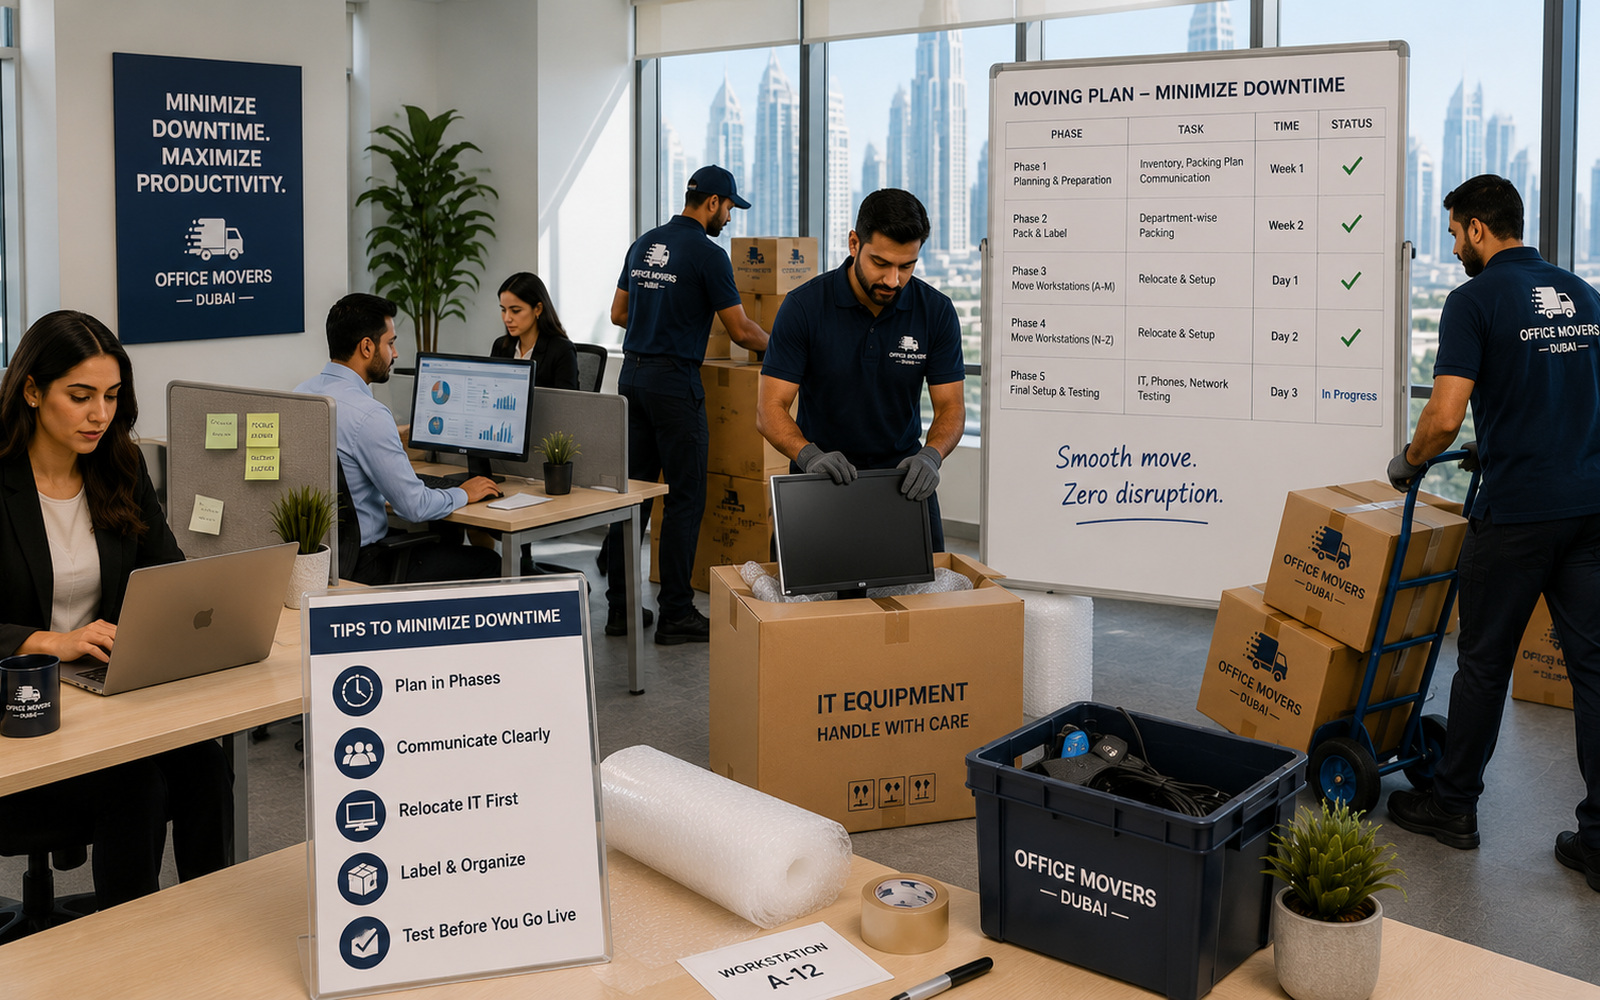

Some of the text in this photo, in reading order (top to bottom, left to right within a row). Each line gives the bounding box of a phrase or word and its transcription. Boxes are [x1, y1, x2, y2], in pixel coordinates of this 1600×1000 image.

[1014, 89, 1082, 107] MOVING
[1088, 87, 1134, 103] PLAN
[1156, 82, 1238, 100] MINIMIZE
[1244, 77, 1345, 96] DOWNTIME
[166, 92, 256, 115] MINIMIZE
[152, 119, 270, 141] DOWNTIME.
[1178, 124, 1204, 134] TASK
[1274, 121, 1299, 131] TIME
[1331, 118, 1372, 129] STATUS
[1051, 129, 1082, 139] PHASE
[162, 147, 262, 167] MAXIMIZE
[1140, 157, 1243, 169] Inventory, Packing Plan
[1014, 162, 1047, 171] Phase 1
[1270, 163, 1304, 173] Week 1
[137, 174, 286, 193] PRODUCTIVITY.
[1014, 175, 1112, 188] Planning & Preparation
[1140, 173, 1210, 183] Communication
[1013, 214, 1047, 223] Phase 2
[1139, 213, 1217, 224] Department-wise
[1269, 220, 1304, 230] Week 2
[1013, 228, 1067, 238] Pack & Label
[1139, 228, 1174, 239] Packing
[1012, 266, 1047, 275] Phase 3
[155, 269, 272, 287] OFFICE MOVERS
[1139, 274, 1216, 286] Relocate & Setup
[1272, 275, 1298, 287] Day 1
[1012, 281, 1115, 292] Move Workstations (A-M)
[196, 292, 235, 306] DUBAI
[1011, 318, 1046, 328] Phase 4
[1138, 328, 1215, 341] Relocate & Setup
[1271, 331, 1298, 343] Day 2
[1520, 324, 1599, 341] OFFICE MOVERS
[1011, 333, 1114, 346] Move Workstations (N-Z)
[1550, 342, 1577, 353] DUBAI
[1011, 370, 1045, 381] Phase 5
[1138, 376, 1228, 388] IT, Phones, Network
[1010, 385, 1100, 400] Final Setup & Testing
[1138, 391, 1171, 403] Testing
[1271, 387, 1298, 399] Day 3
[1322, 389, 1378, 402] In Progress
[1056, 444, 1197, 469] Smooth move.
[1062, 481, 1223, 511] Zero disruption.
[1284, 554, 1366, 599] OFFICE MOVERS
[1305, 582, 1334, 603] DUBAI
[330, 608, 561, 638] TIPS TO MINIMIZE DOWNTIME
[395, 672, 501, 693] Plan in Phases
[1218, 660, 1302, 716] OFFICE MOVERS
[817, 682, 969, 714] IT EQUIPMENT
[1240, 692, 1268, 716] DUBAI
[817, 713, 969, 741] HANDLE WITH CARE
[397, 727, 551, 754] Communicate Clearly
[399, 792, 518, 817] Relocate IT First
[401, 852, 526, 880] Label & Organize
[1014, 849, 1157, 908] OFFICE MOVERS
[1060, 889, 1108, 917] DUBAI
[403, 908, 576, 943] Test Before You Go Live
[717, 942, 829, 978] WORKSTATION
[767, 963, 824, 990] A-12
